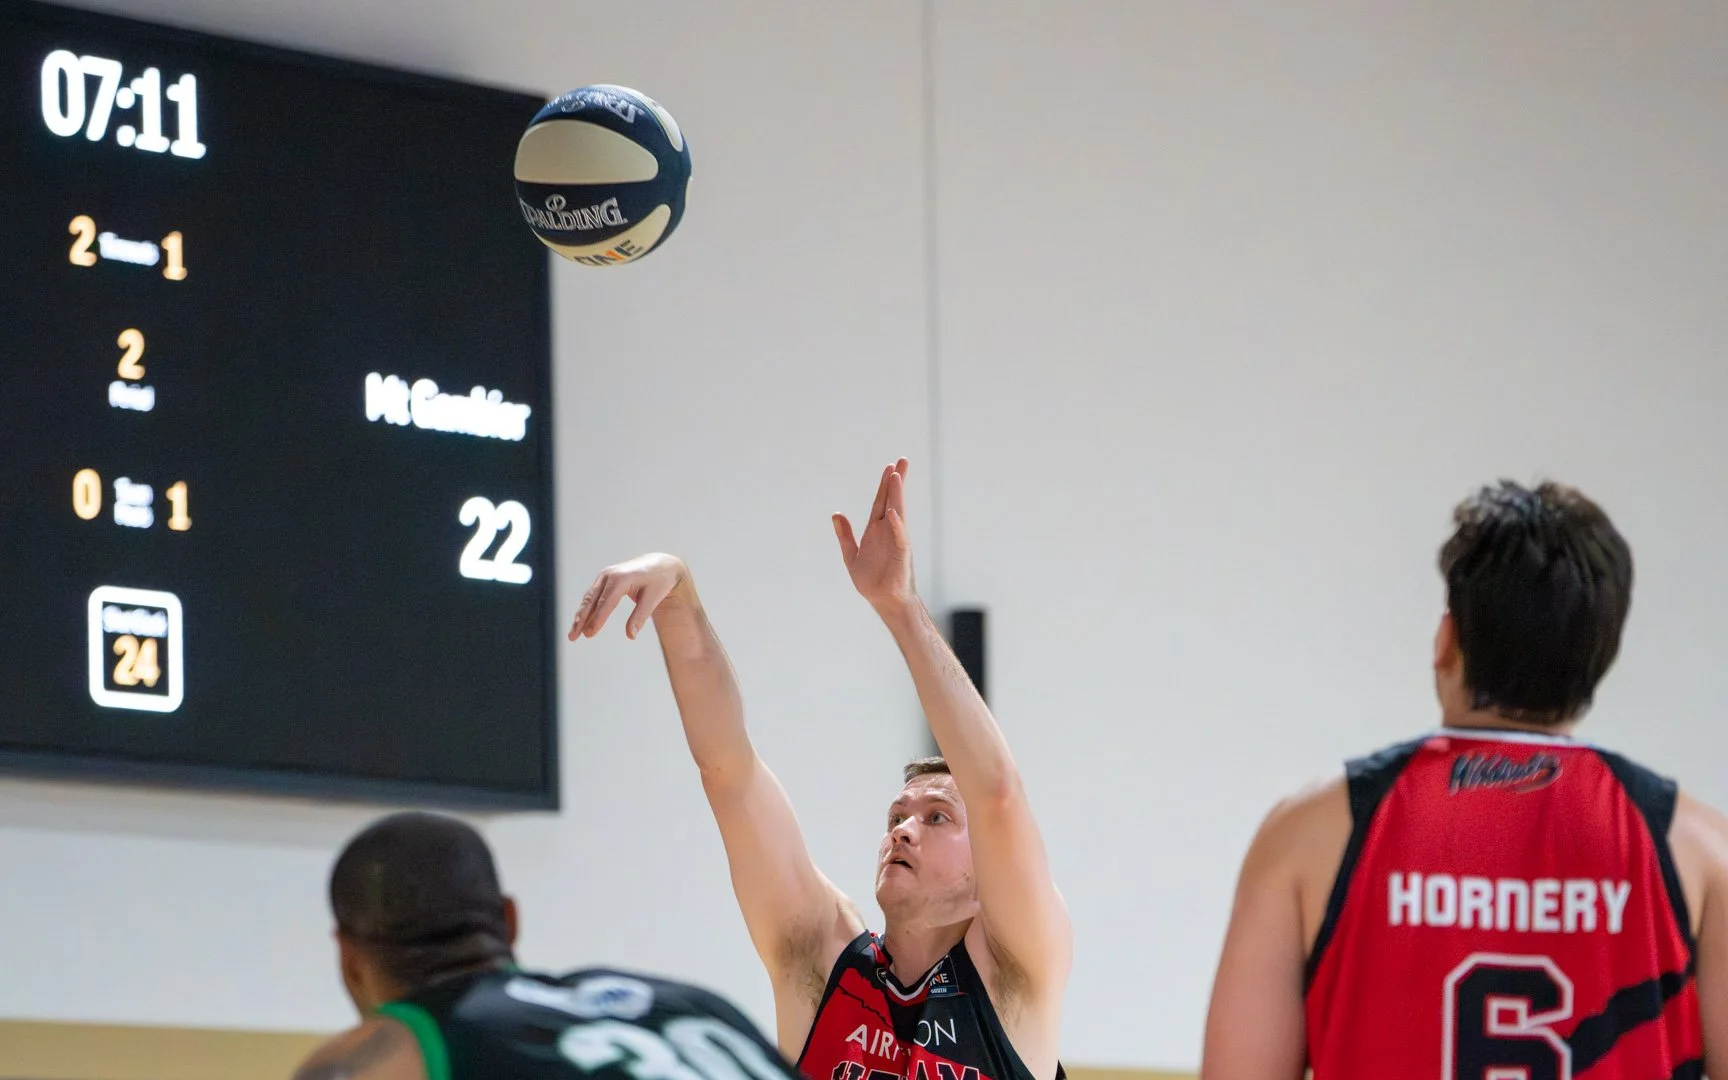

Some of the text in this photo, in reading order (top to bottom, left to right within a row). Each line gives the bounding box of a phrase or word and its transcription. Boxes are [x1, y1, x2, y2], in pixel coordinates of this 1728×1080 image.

[41, 50, 206, 159] 07:11
[69, 215, 97, 267] 2
[161, 231, 187, 281] 1
[117, 328, 145, 379] 2
[73, 468, 101, 520] 0
[166, 481, 192, 531] 1
[459, 496, 532, 584] 22
[113, 634, 160, 688] 24
[1388, 872, 1631, 933] HORNERY
